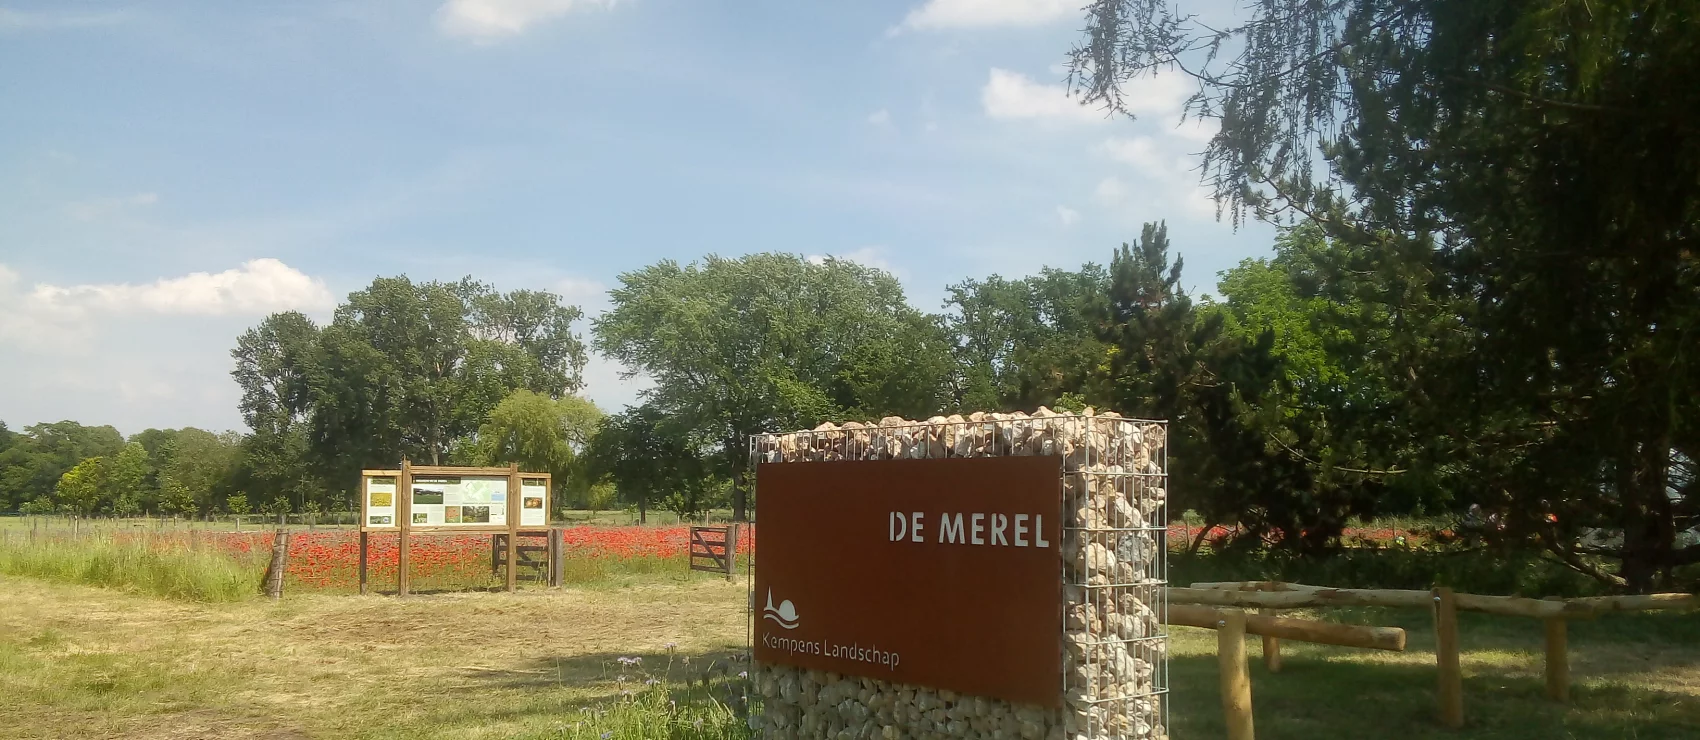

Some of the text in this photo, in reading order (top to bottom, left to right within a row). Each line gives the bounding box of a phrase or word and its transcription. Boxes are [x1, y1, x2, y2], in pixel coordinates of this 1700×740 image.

[889, 511, 1050, 548] DE MEREL
[762, 632, 900, 671] Kempens Landschap
